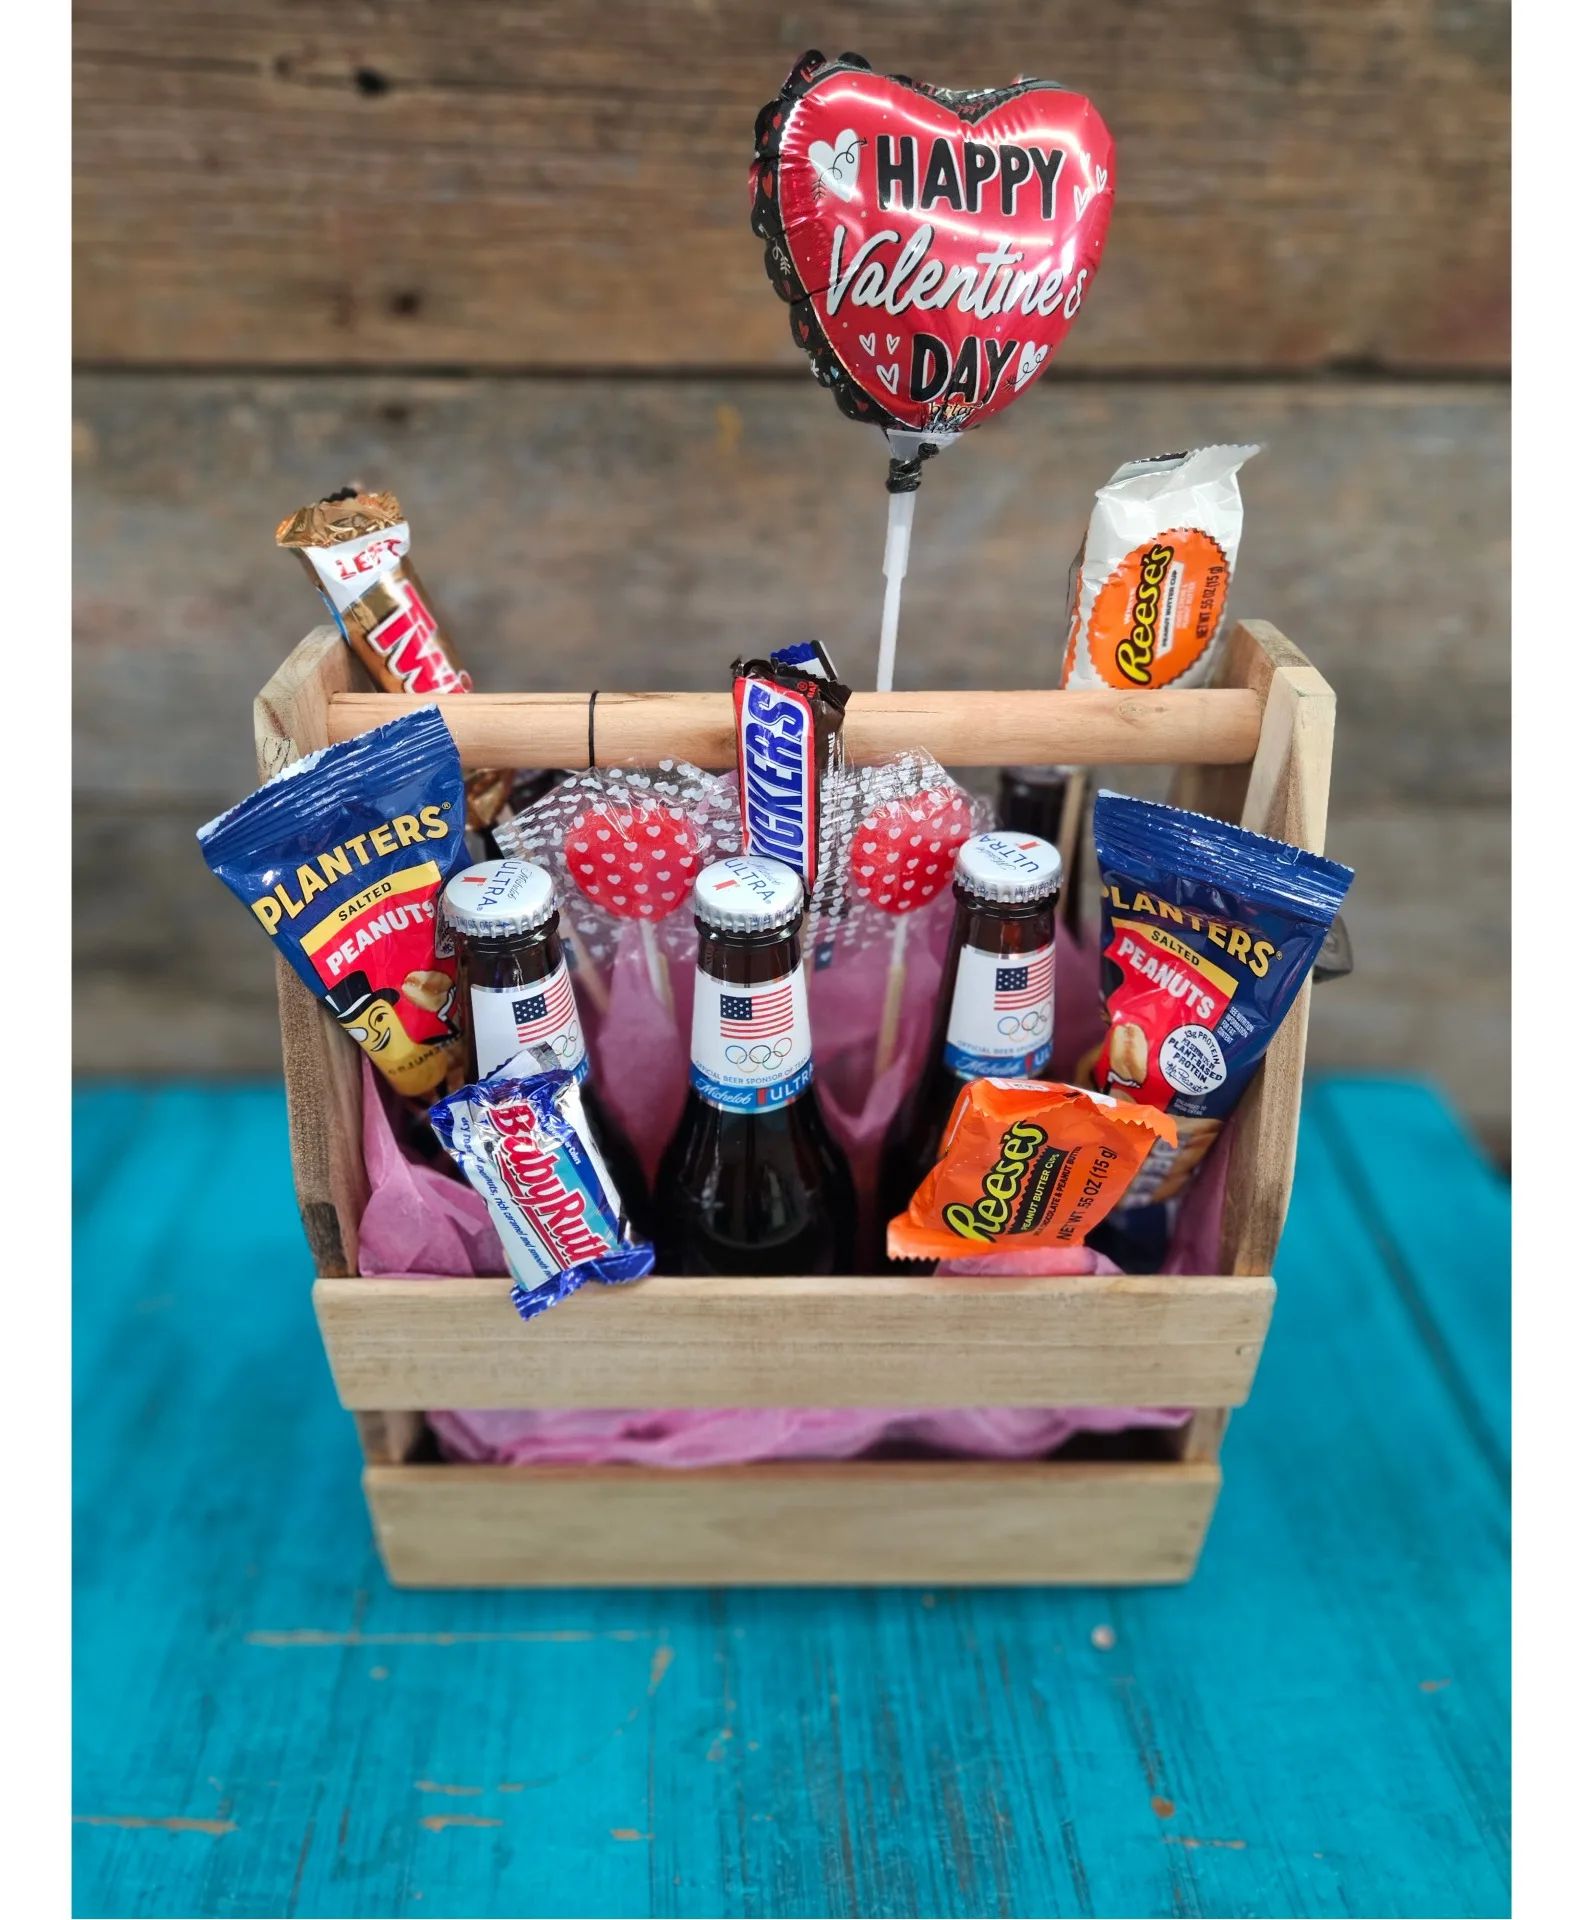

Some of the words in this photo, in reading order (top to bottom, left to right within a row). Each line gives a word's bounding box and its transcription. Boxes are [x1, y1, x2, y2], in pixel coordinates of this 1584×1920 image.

[876, 135, 1064, 220] HAPPY
[910, 333, 1017, 404] DAY
[1116, 544, 1175, 684] Reese's
[250, 805, 449, 936] PLANTERS
[979, 834, 1040, 873] ULTRA
[478, 861, 522, 907] ULTRA
[724, 858, 775, 901] ULTRA
[339, 881, 392, 922] SALTED
[326, 900, 435, 977] PEANUTS
[1151, 930, 1200, 966] SALTED
[1117, 936, 1216, 1019] PEANUTS
[1168, 1037, 1223, 1081] PLANT-BASED
[1173, 1052, 1208, 1084] PROTEIN
[1197, 1030, 1221, 1066] PROTEIN
[695, 1078, 754, 1105] Michelob
[723, 1075, 744, 1084] BEER
[745, 1072, 783, 1085] SPONSOR
[1088, 1158, 1110, 1179] (15
[1098, 1145, 1119, 1160] g)
[943, 1120, 1047, 1243] Reese's
[1057, 1165, 1073, 1193] PEANUT
[1083, 1178, 1103, 1196] OZ
[495, 1196, 508, 1211] rich
[503, 1210, 524, 1237] caramel
[1021, 1202, 1039, 1231] PEANUT
[1032, 1169, 1051, 1202] BUTTER
